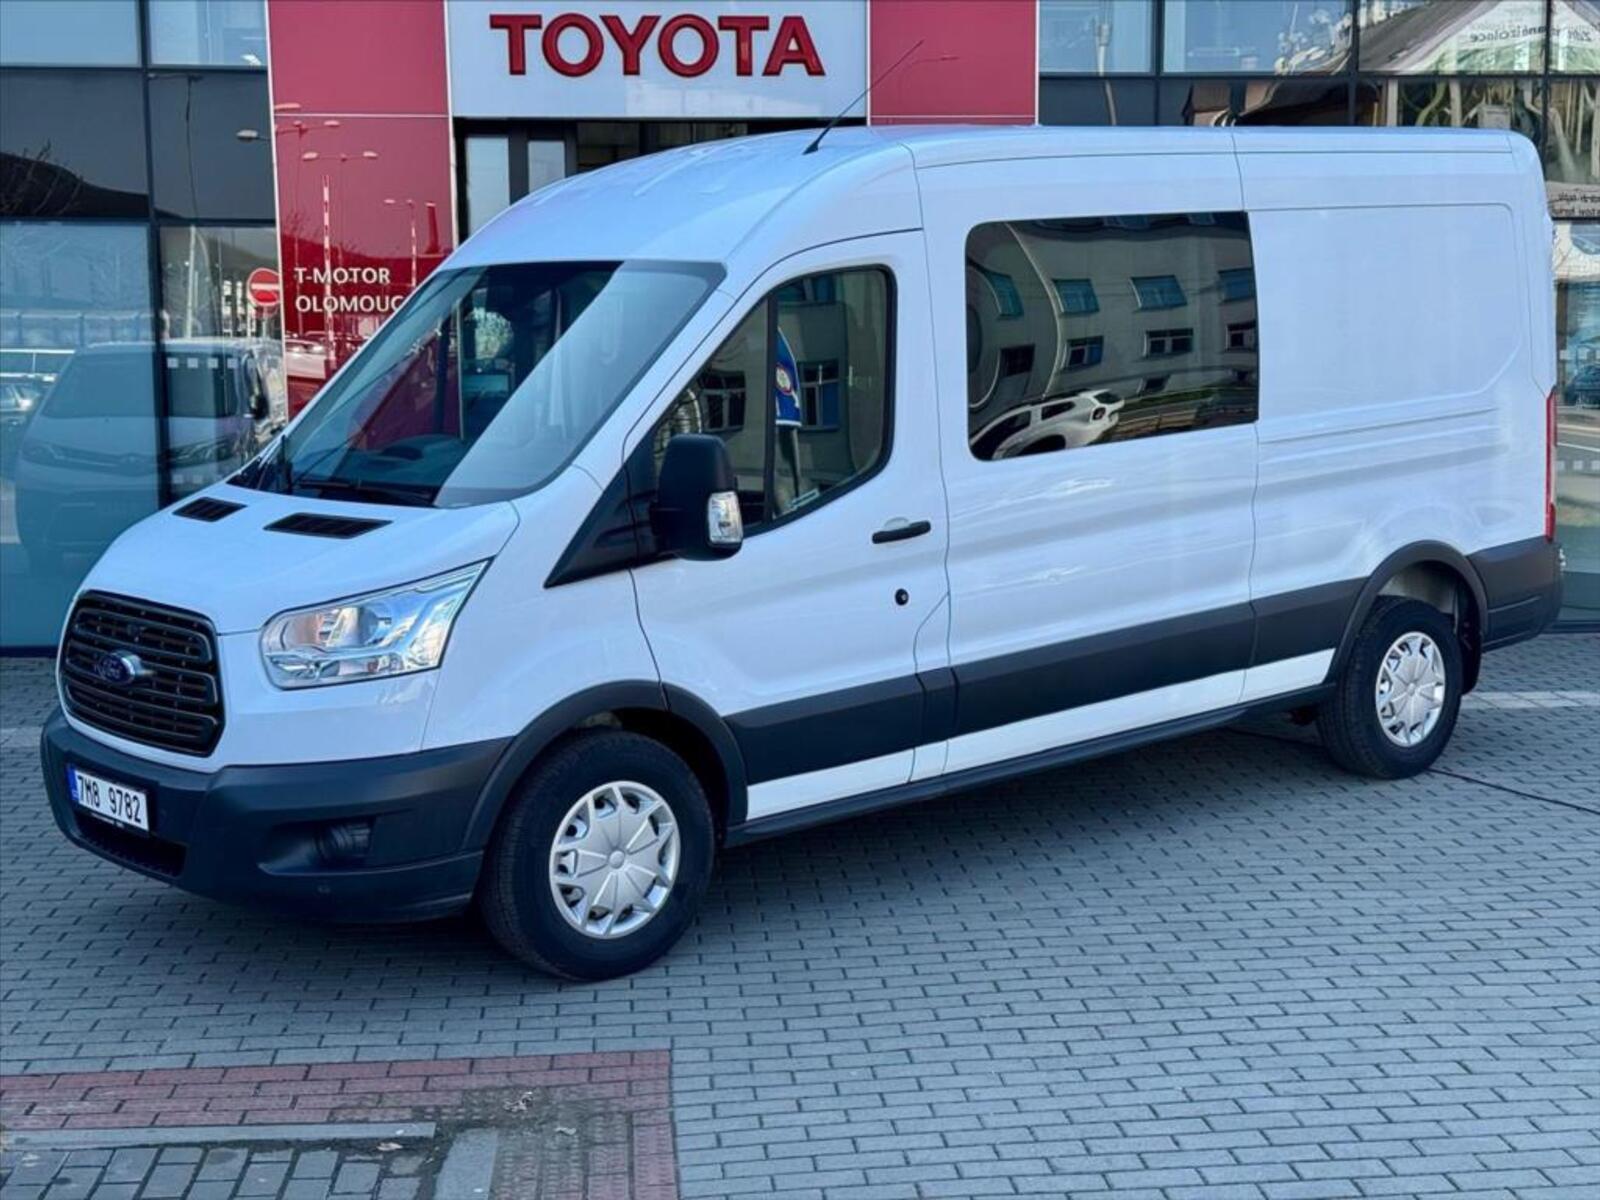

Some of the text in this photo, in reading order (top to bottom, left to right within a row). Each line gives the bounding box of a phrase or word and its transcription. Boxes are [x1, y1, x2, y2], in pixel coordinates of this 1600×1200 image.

[489, 12, 826, 78] TOYOTA
[294, 267, 391, 284] T-MOTOR
[77, 775, 142, 824] 7M8 9782
